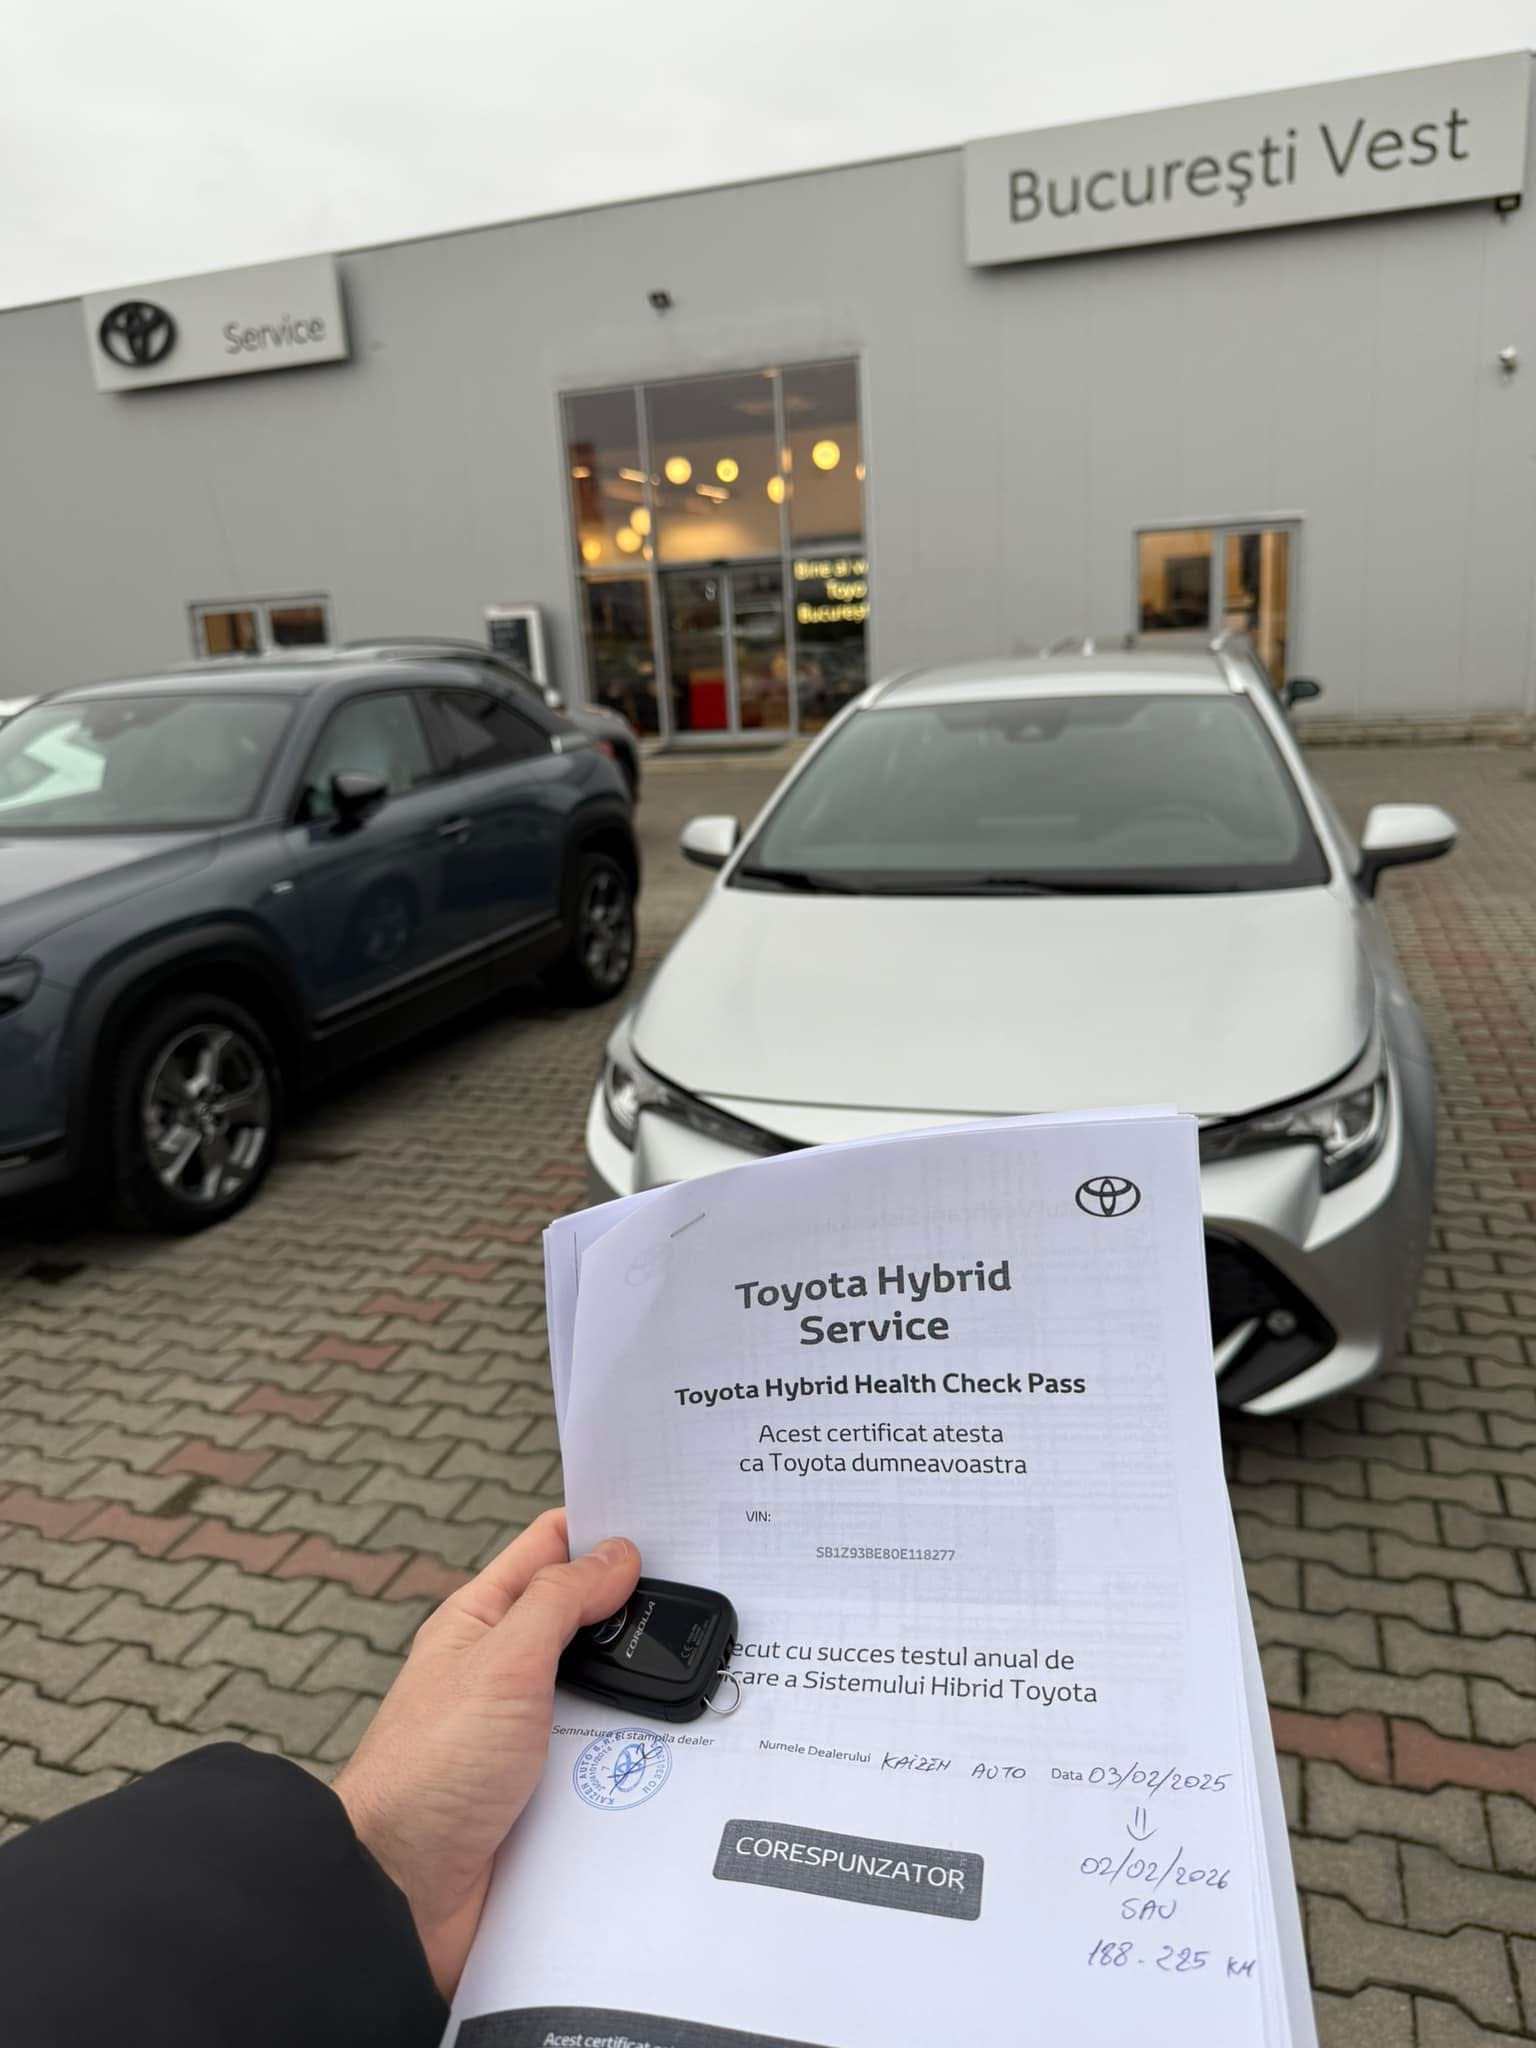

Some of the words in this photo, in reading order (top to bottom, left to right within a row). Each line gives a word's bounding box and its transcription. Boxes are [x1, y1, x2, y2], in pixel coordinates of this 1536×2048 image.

[1320, 107, 1471, 178] Vest
[223, 311, 325, 355] Service
[735, 1272, 868, 1311] Toyota
[878, 1260, 1012, 1302] Hybrid
[800, 1310, 950, 1345] Service
[674, 1382, 760, 1407] Toyota
[765, 1375, 849, 1401] Hybrid
[855, 1373, 937, 1394] Health
[942, 1372, 1023, 1394] Check
[1028, 1373, 1086, 1394] Pass
[758, 1424, 822, 1444] Acest
[827, 1423, 928, 1442] certificat
[932, 1425, 1004, 1443] atesta
[739, 1458, 764, 1472] ca
[768, 1453, 847, 1476] Toyota
[851, 1453, 1028, 1474] dumneavoastra
[745, 1511, 772, 1522] VIN:
[625, 1600, 656, 1659] COROLLA
[785, 1647, 812, 1661] cu
[817, 1647, 896, 1664] succes
[901, 1645, 968, 1667] testul
[973, 1649, 1038, 1669] anual
[1045, 1651, 1075, 1670] de
[784, 1674, 798, 1689] a
[802, 1670, 926, 1696] Sistemului
[931, 1676, 1004, 1699] Hibrid
[1010, 1680, 1098, 1706] Toyota
[552, 1725, 613, 1738] Semnatura
[626, 1733, 675, 1744] stampila
[677, 1735, 714, 1746] dealer
[759, 1740, 806, 1754] Numele
[808, 1745, 872, 1763] Dealerului
[971, 1763, 1027, 1780] AUTO
[1051, 1768, 1083, 1781] Data
[1088, 1762, 1232, 1798] 03/02/2025
[735, 1836, 966, 1894] CORESPUNZATOR
[1080, 1846, 1231, 1893] 02/02/2026
